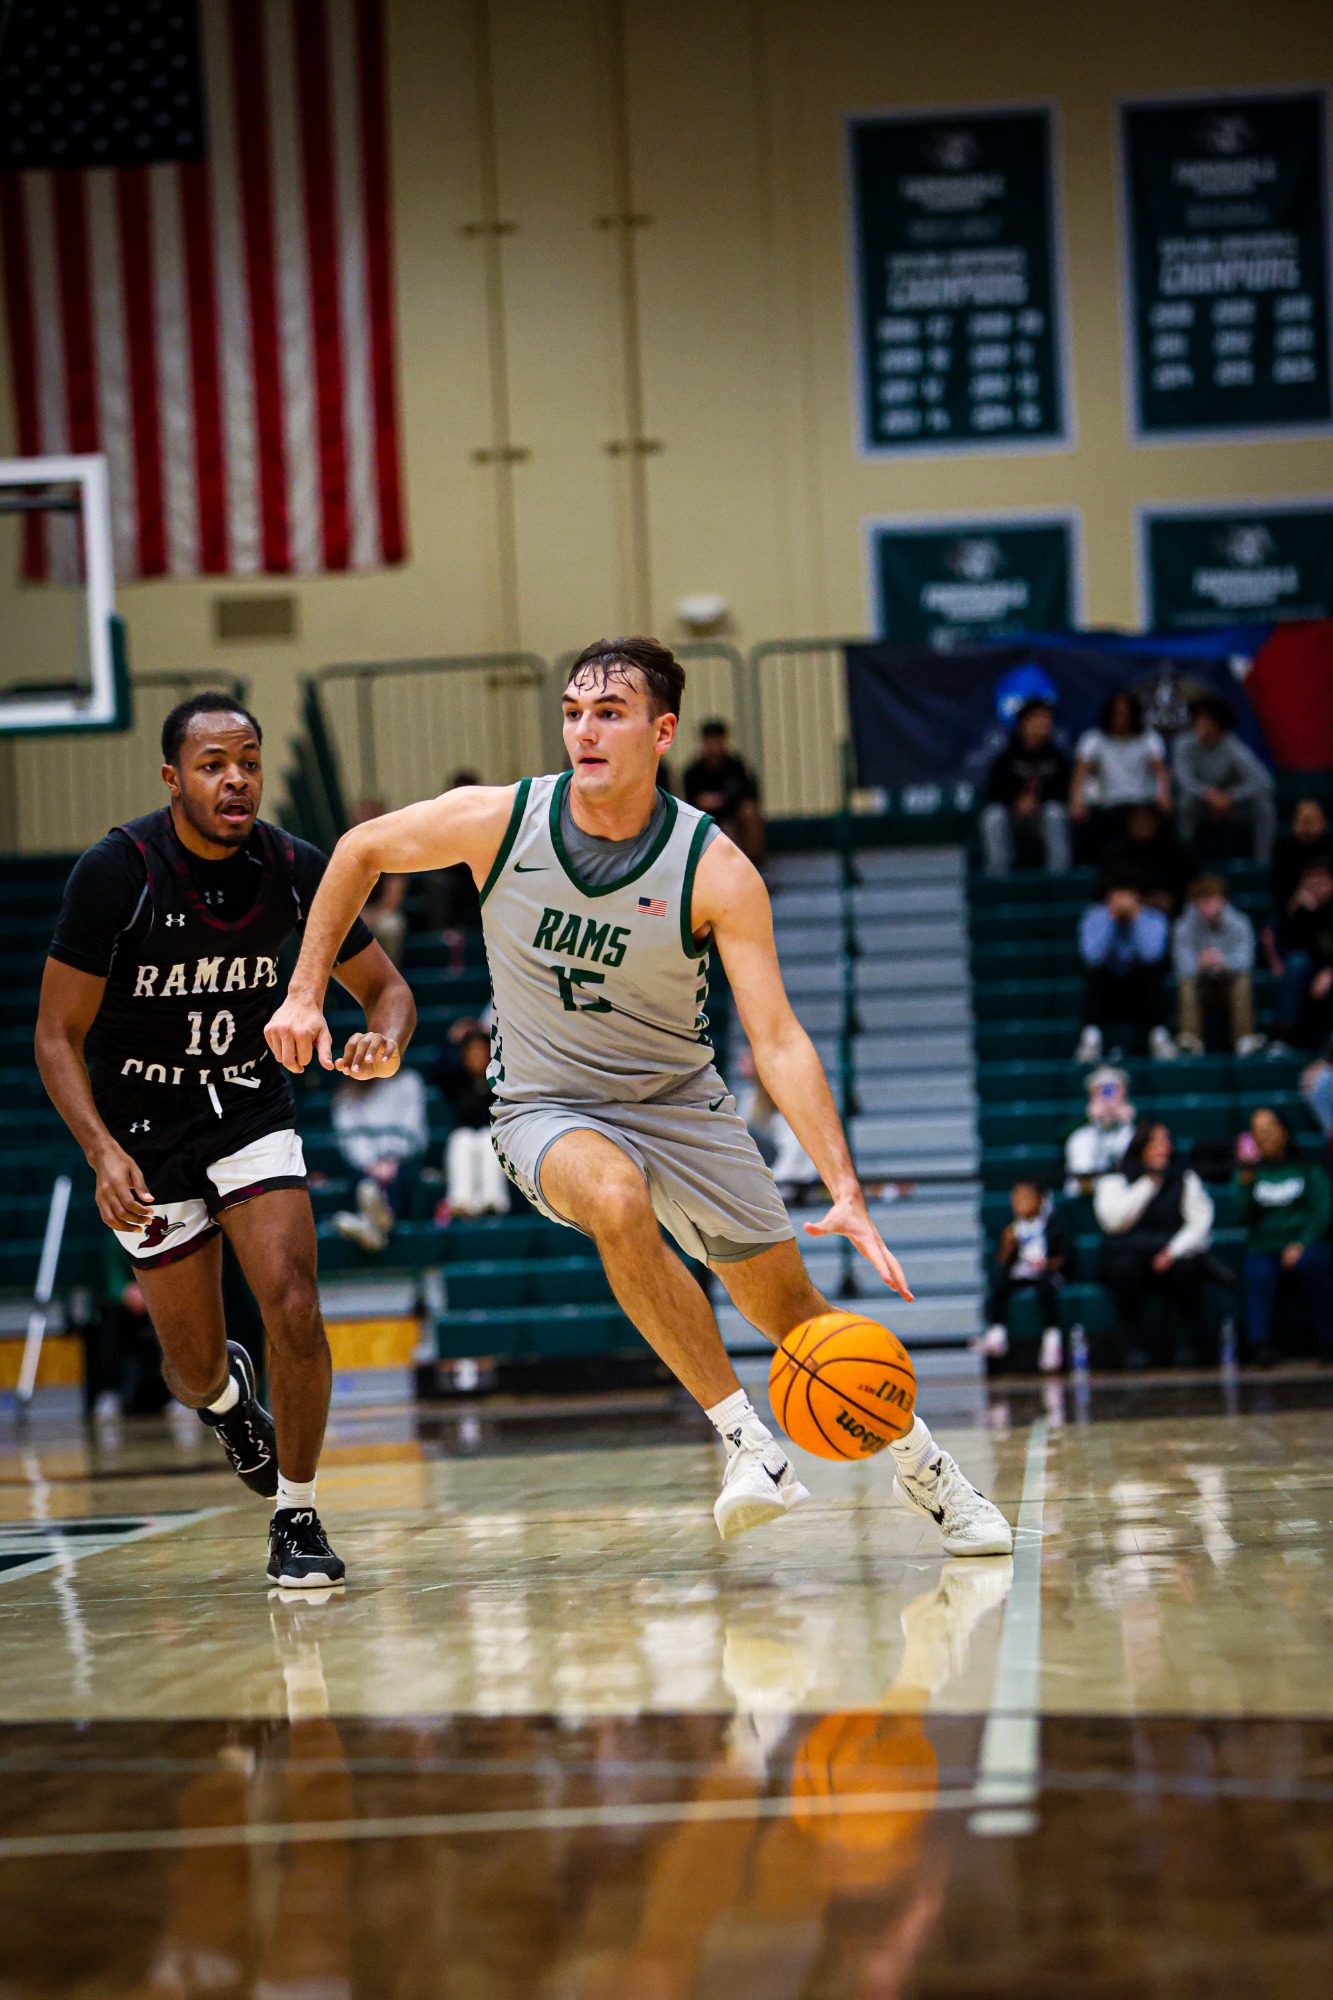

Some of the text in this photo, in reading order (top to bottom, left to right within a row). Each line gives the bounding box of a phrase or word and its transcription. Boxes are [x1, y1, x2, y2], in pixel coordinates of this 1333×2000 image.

[532, 907, 632, 968] RAMS
[550, 965, 613, 1014] 15
[184, 1009, 237, 1056] 10
